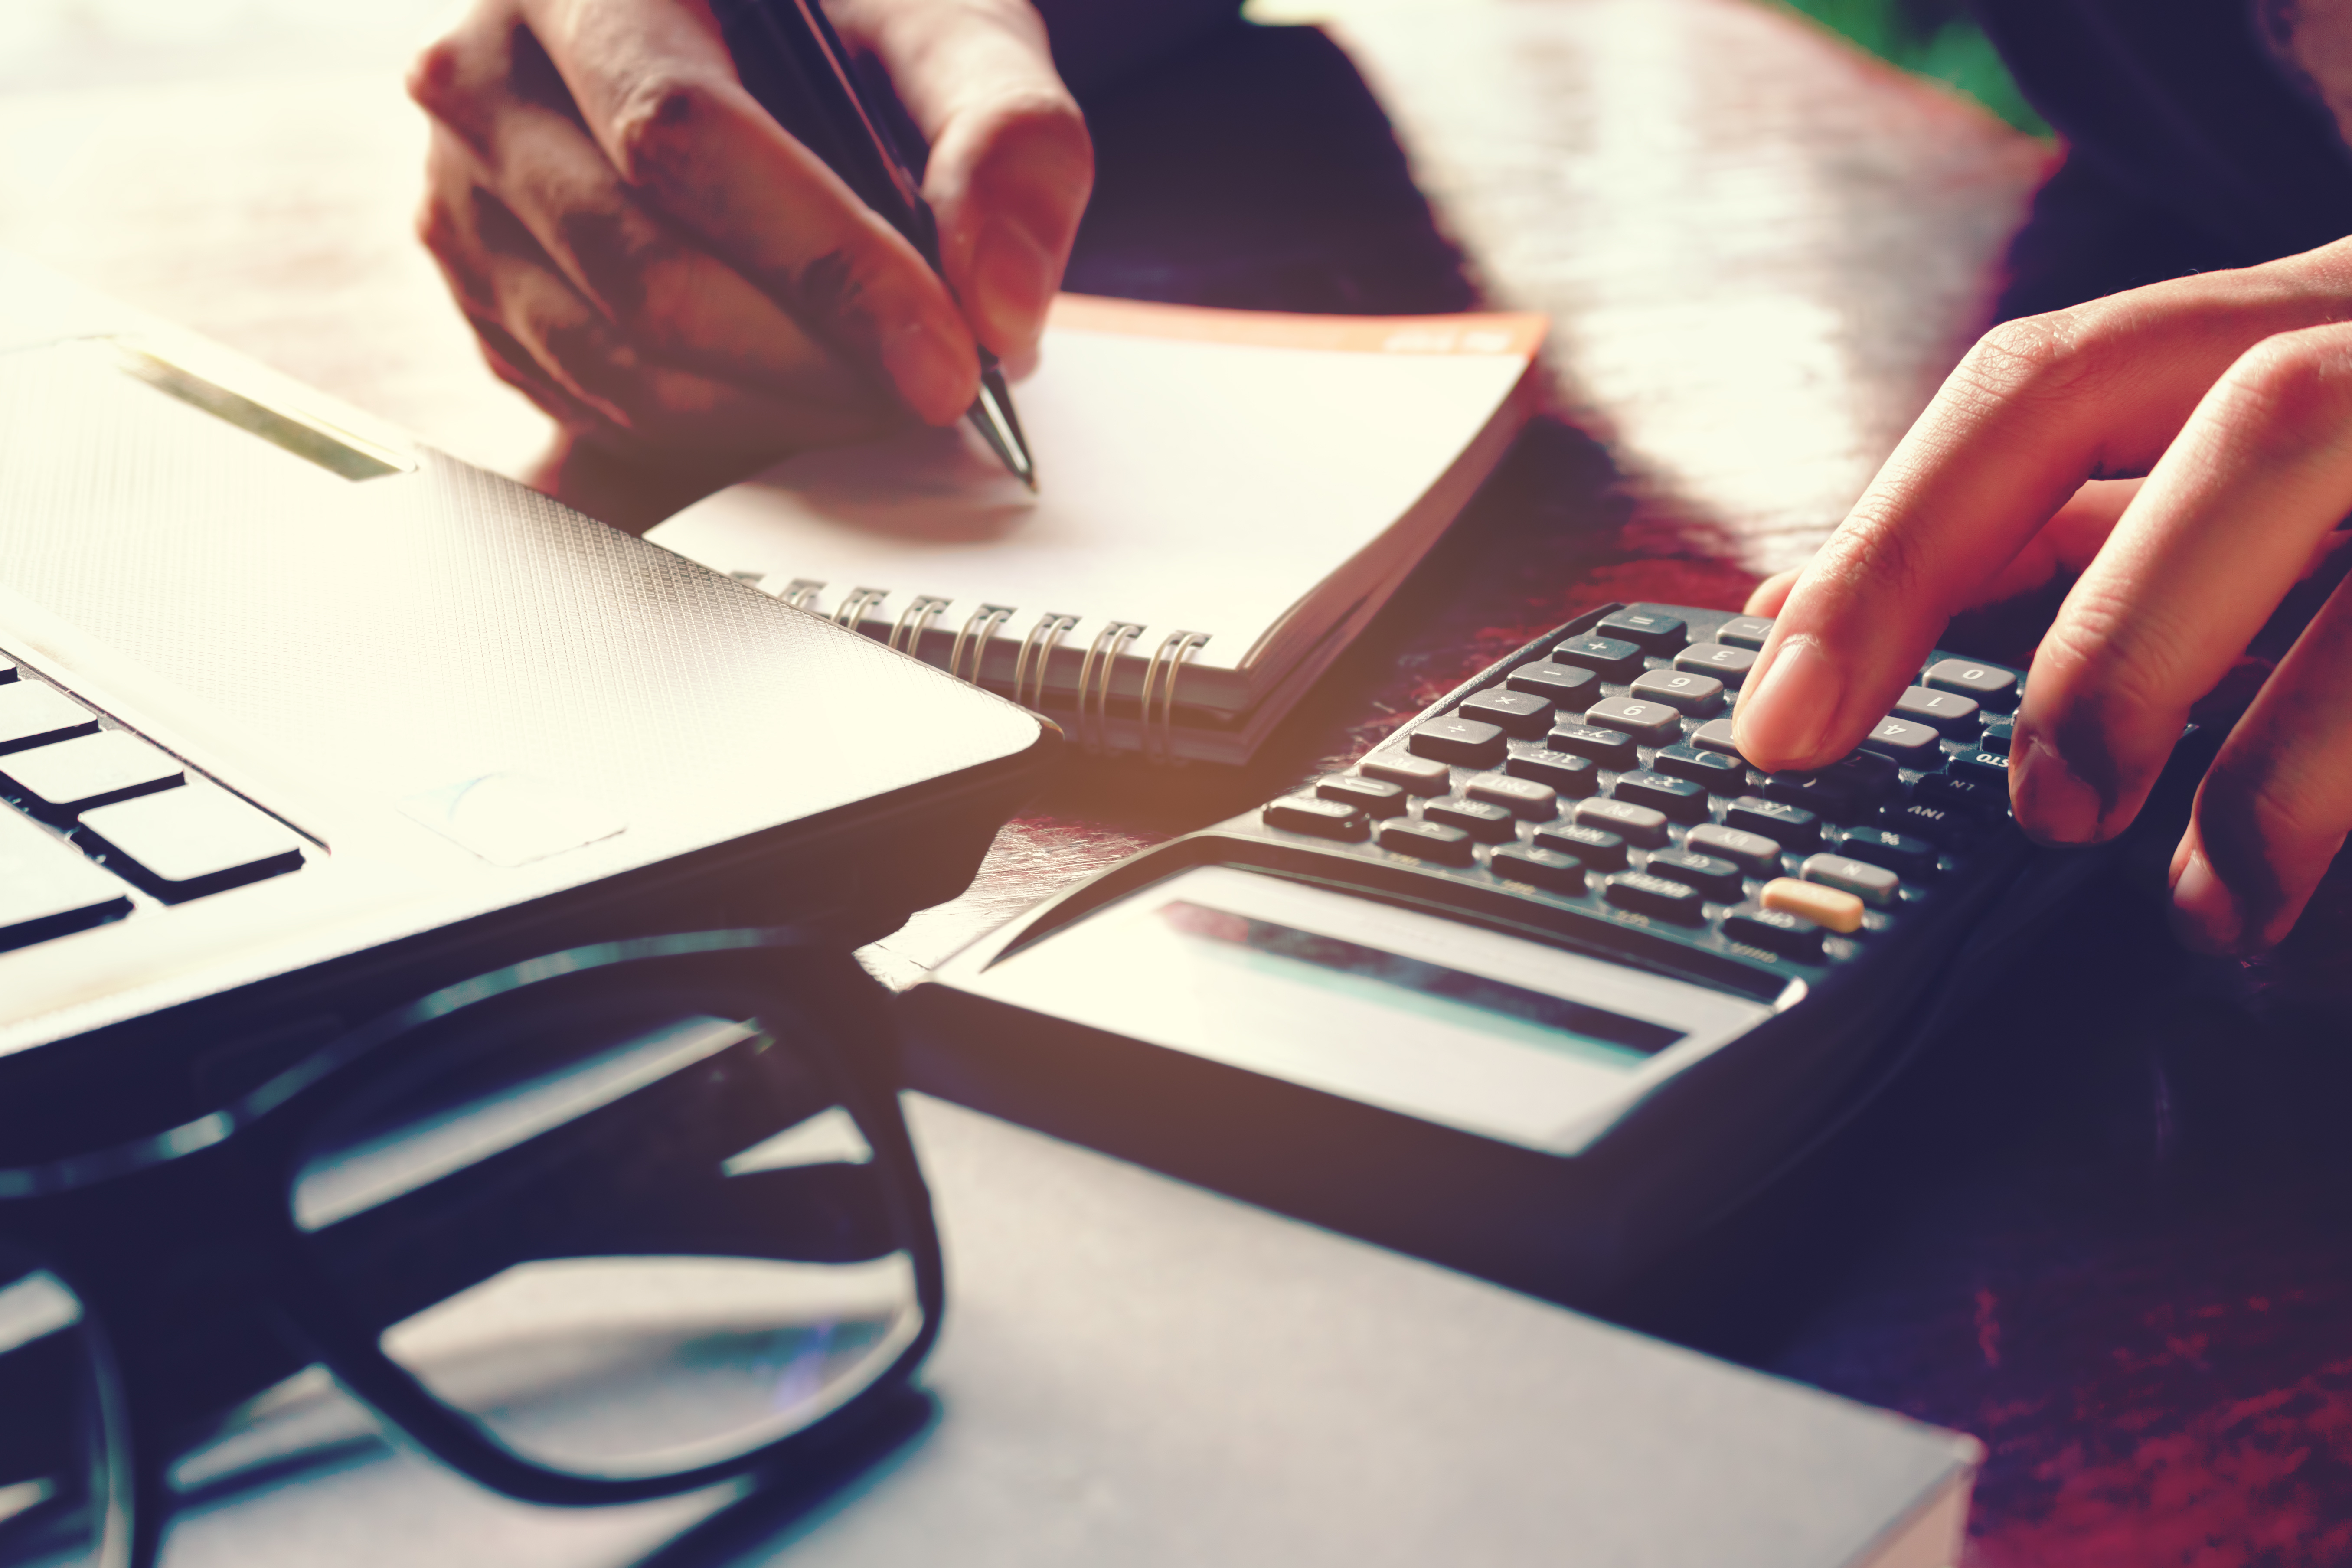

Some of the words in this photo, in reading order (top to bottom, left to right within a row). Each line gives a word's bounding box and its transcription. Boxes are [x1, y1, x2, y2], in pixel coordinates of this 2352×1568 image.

[1712, 650, 1735, 661] 3
[1962, 669, 1985, 680] 0
[1667, 677, 1692, 688] 6
[1926, 696, 1944, 708] 1
[1623, 705, 1647, 716] 9
[1883, 724, 1907, 735] 4
[1976, 753, 2009, 768] STO
[1949, 779, 1975, 791] LN
[1606, 804, 1633, 817] PV
[1907, 805, 1945, 821] INV
[1880, 831, 1900, 846] %
[1842, 863, 1862, 876] N
